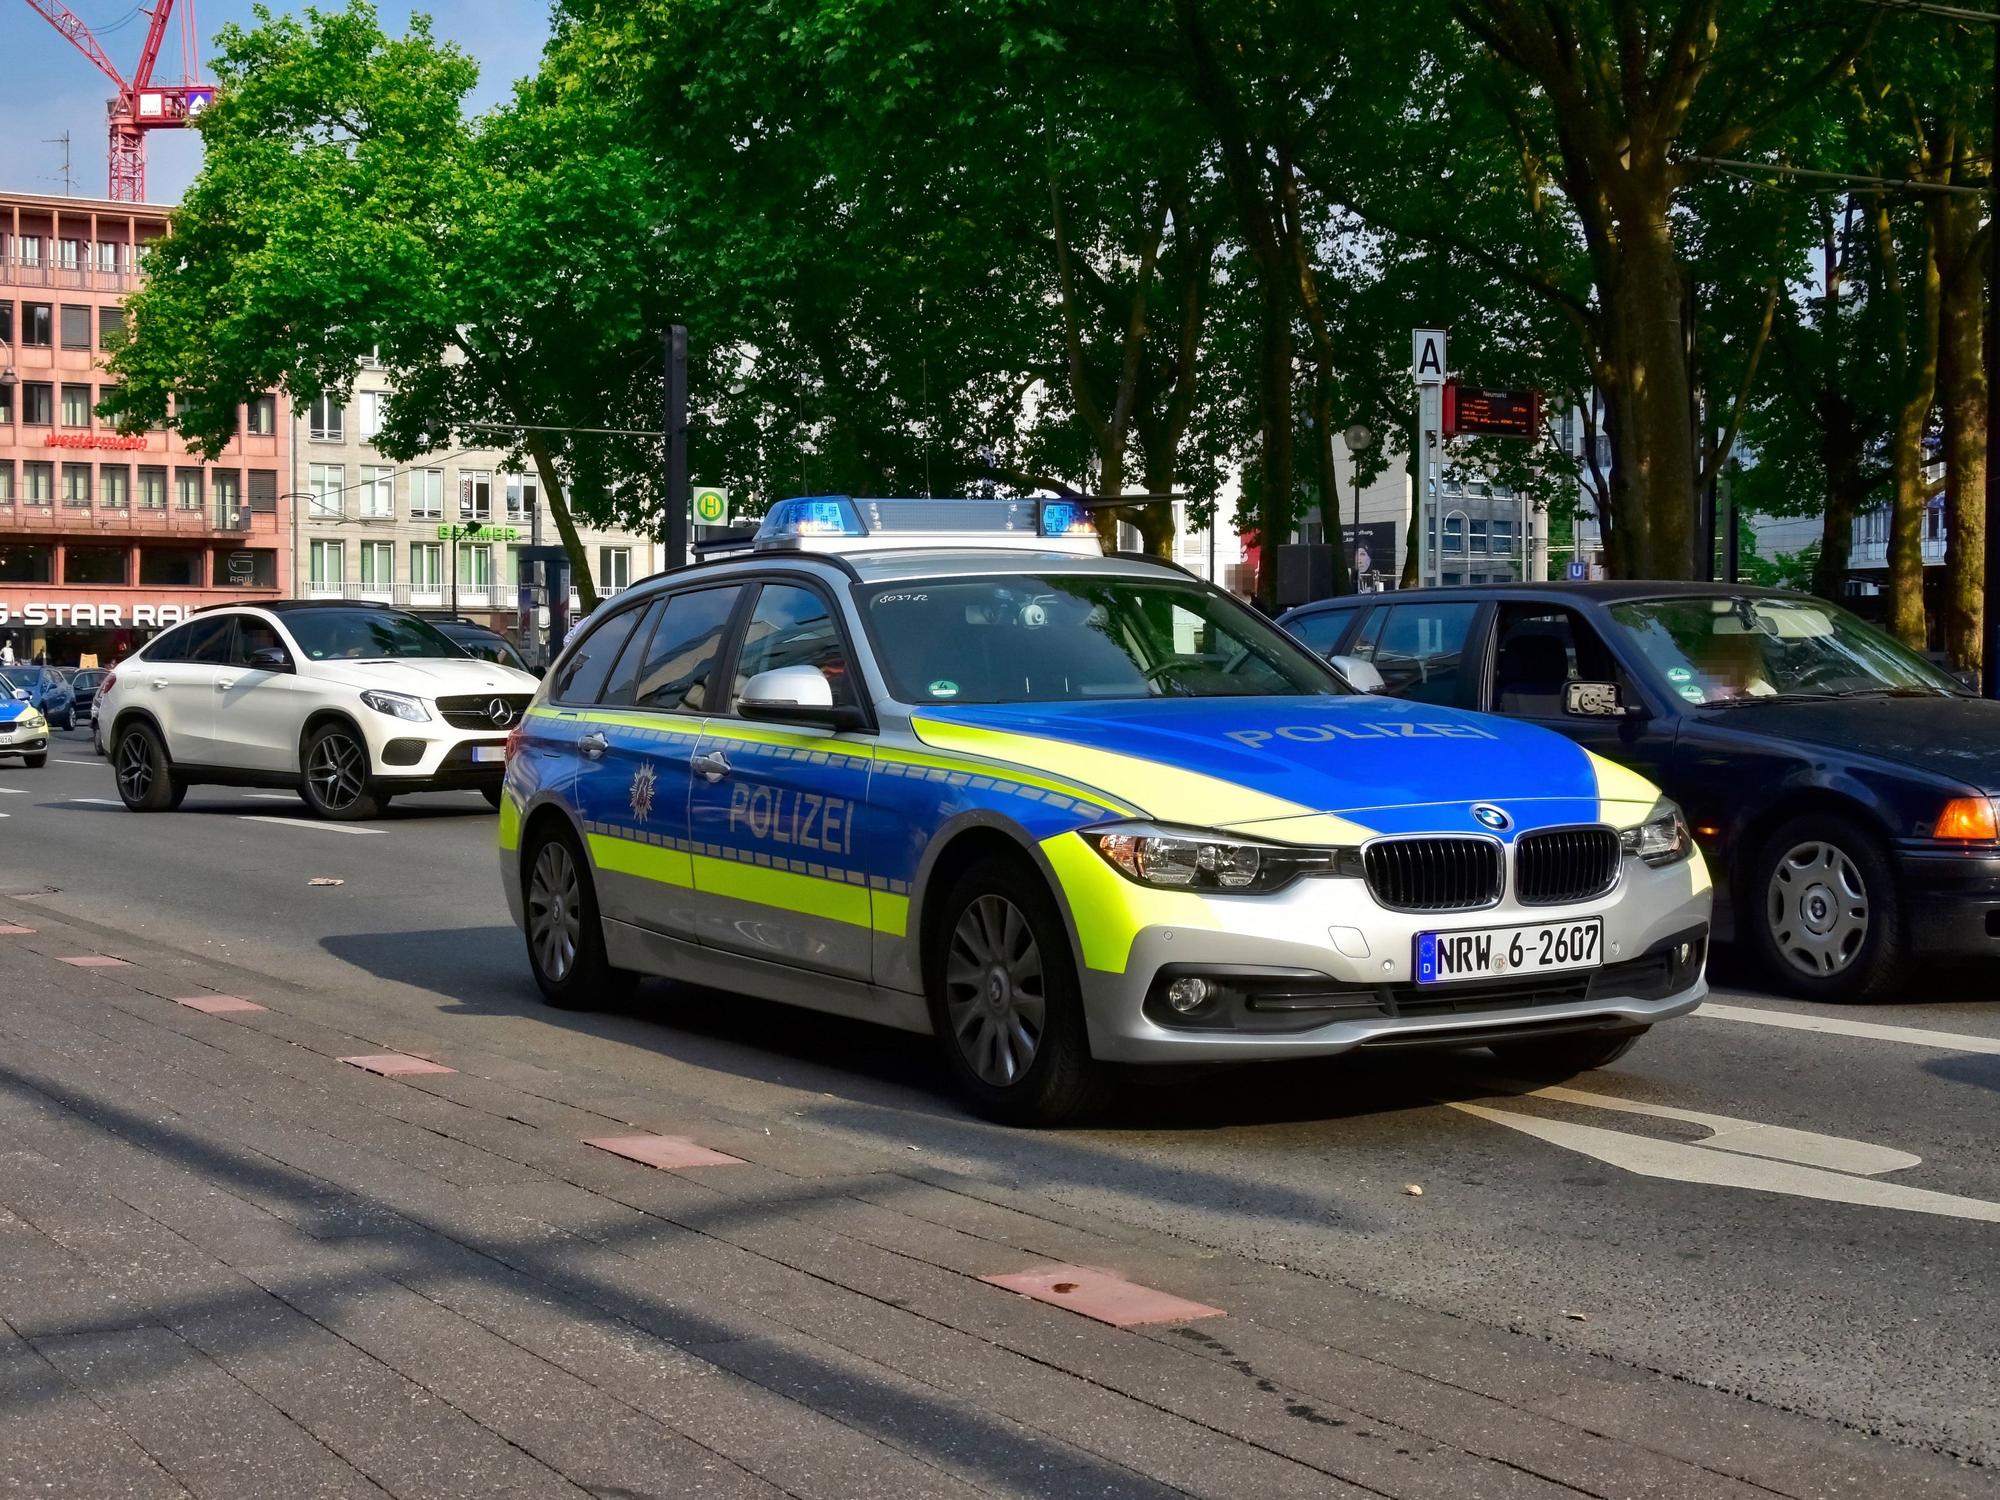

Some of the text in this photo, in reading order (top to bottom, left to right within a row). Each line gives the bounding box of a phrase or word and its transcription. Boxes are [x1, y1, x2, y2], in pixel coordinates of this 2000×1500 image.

[1418, 338, 1441, 374] A
[44, 433, 147, 451] westermann
[705, 498, 716, 514] H
[1572, 565, 1582, 577] U
[1224, 723, 1499, 749] POLIZEI
[730, 783, 854, 855] POLIZEI
[1437, 924, 1599, 974] NRW 6-2607
[1423, 963, 1431, 974] D
